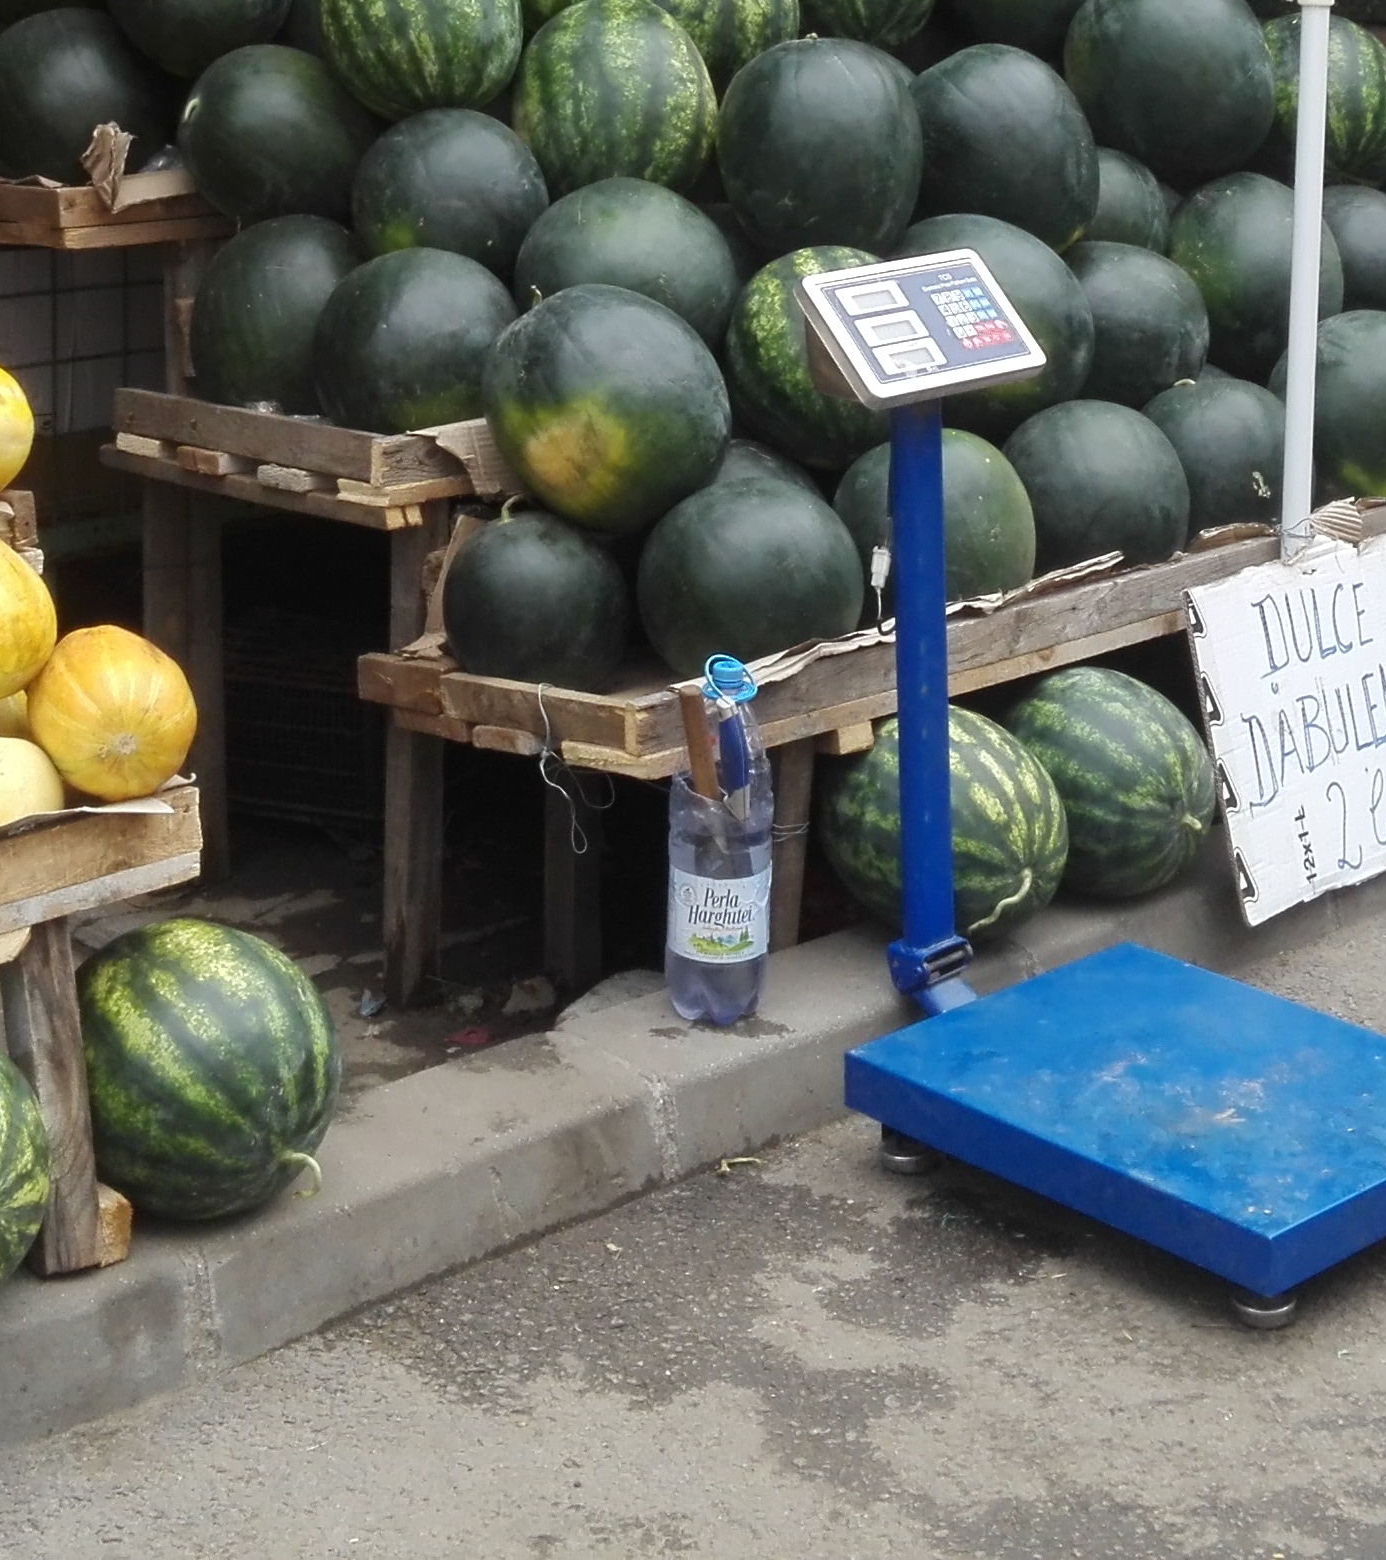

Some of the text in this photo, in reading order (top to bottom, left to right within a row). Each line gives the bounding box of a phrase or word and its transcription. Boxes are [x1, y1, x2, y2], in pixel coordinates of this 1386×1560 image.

[1251, 582, 1374, 680] DULCE
[1325, 781, 1363, 870] 2
[704, 887, 739, 909] Perla
